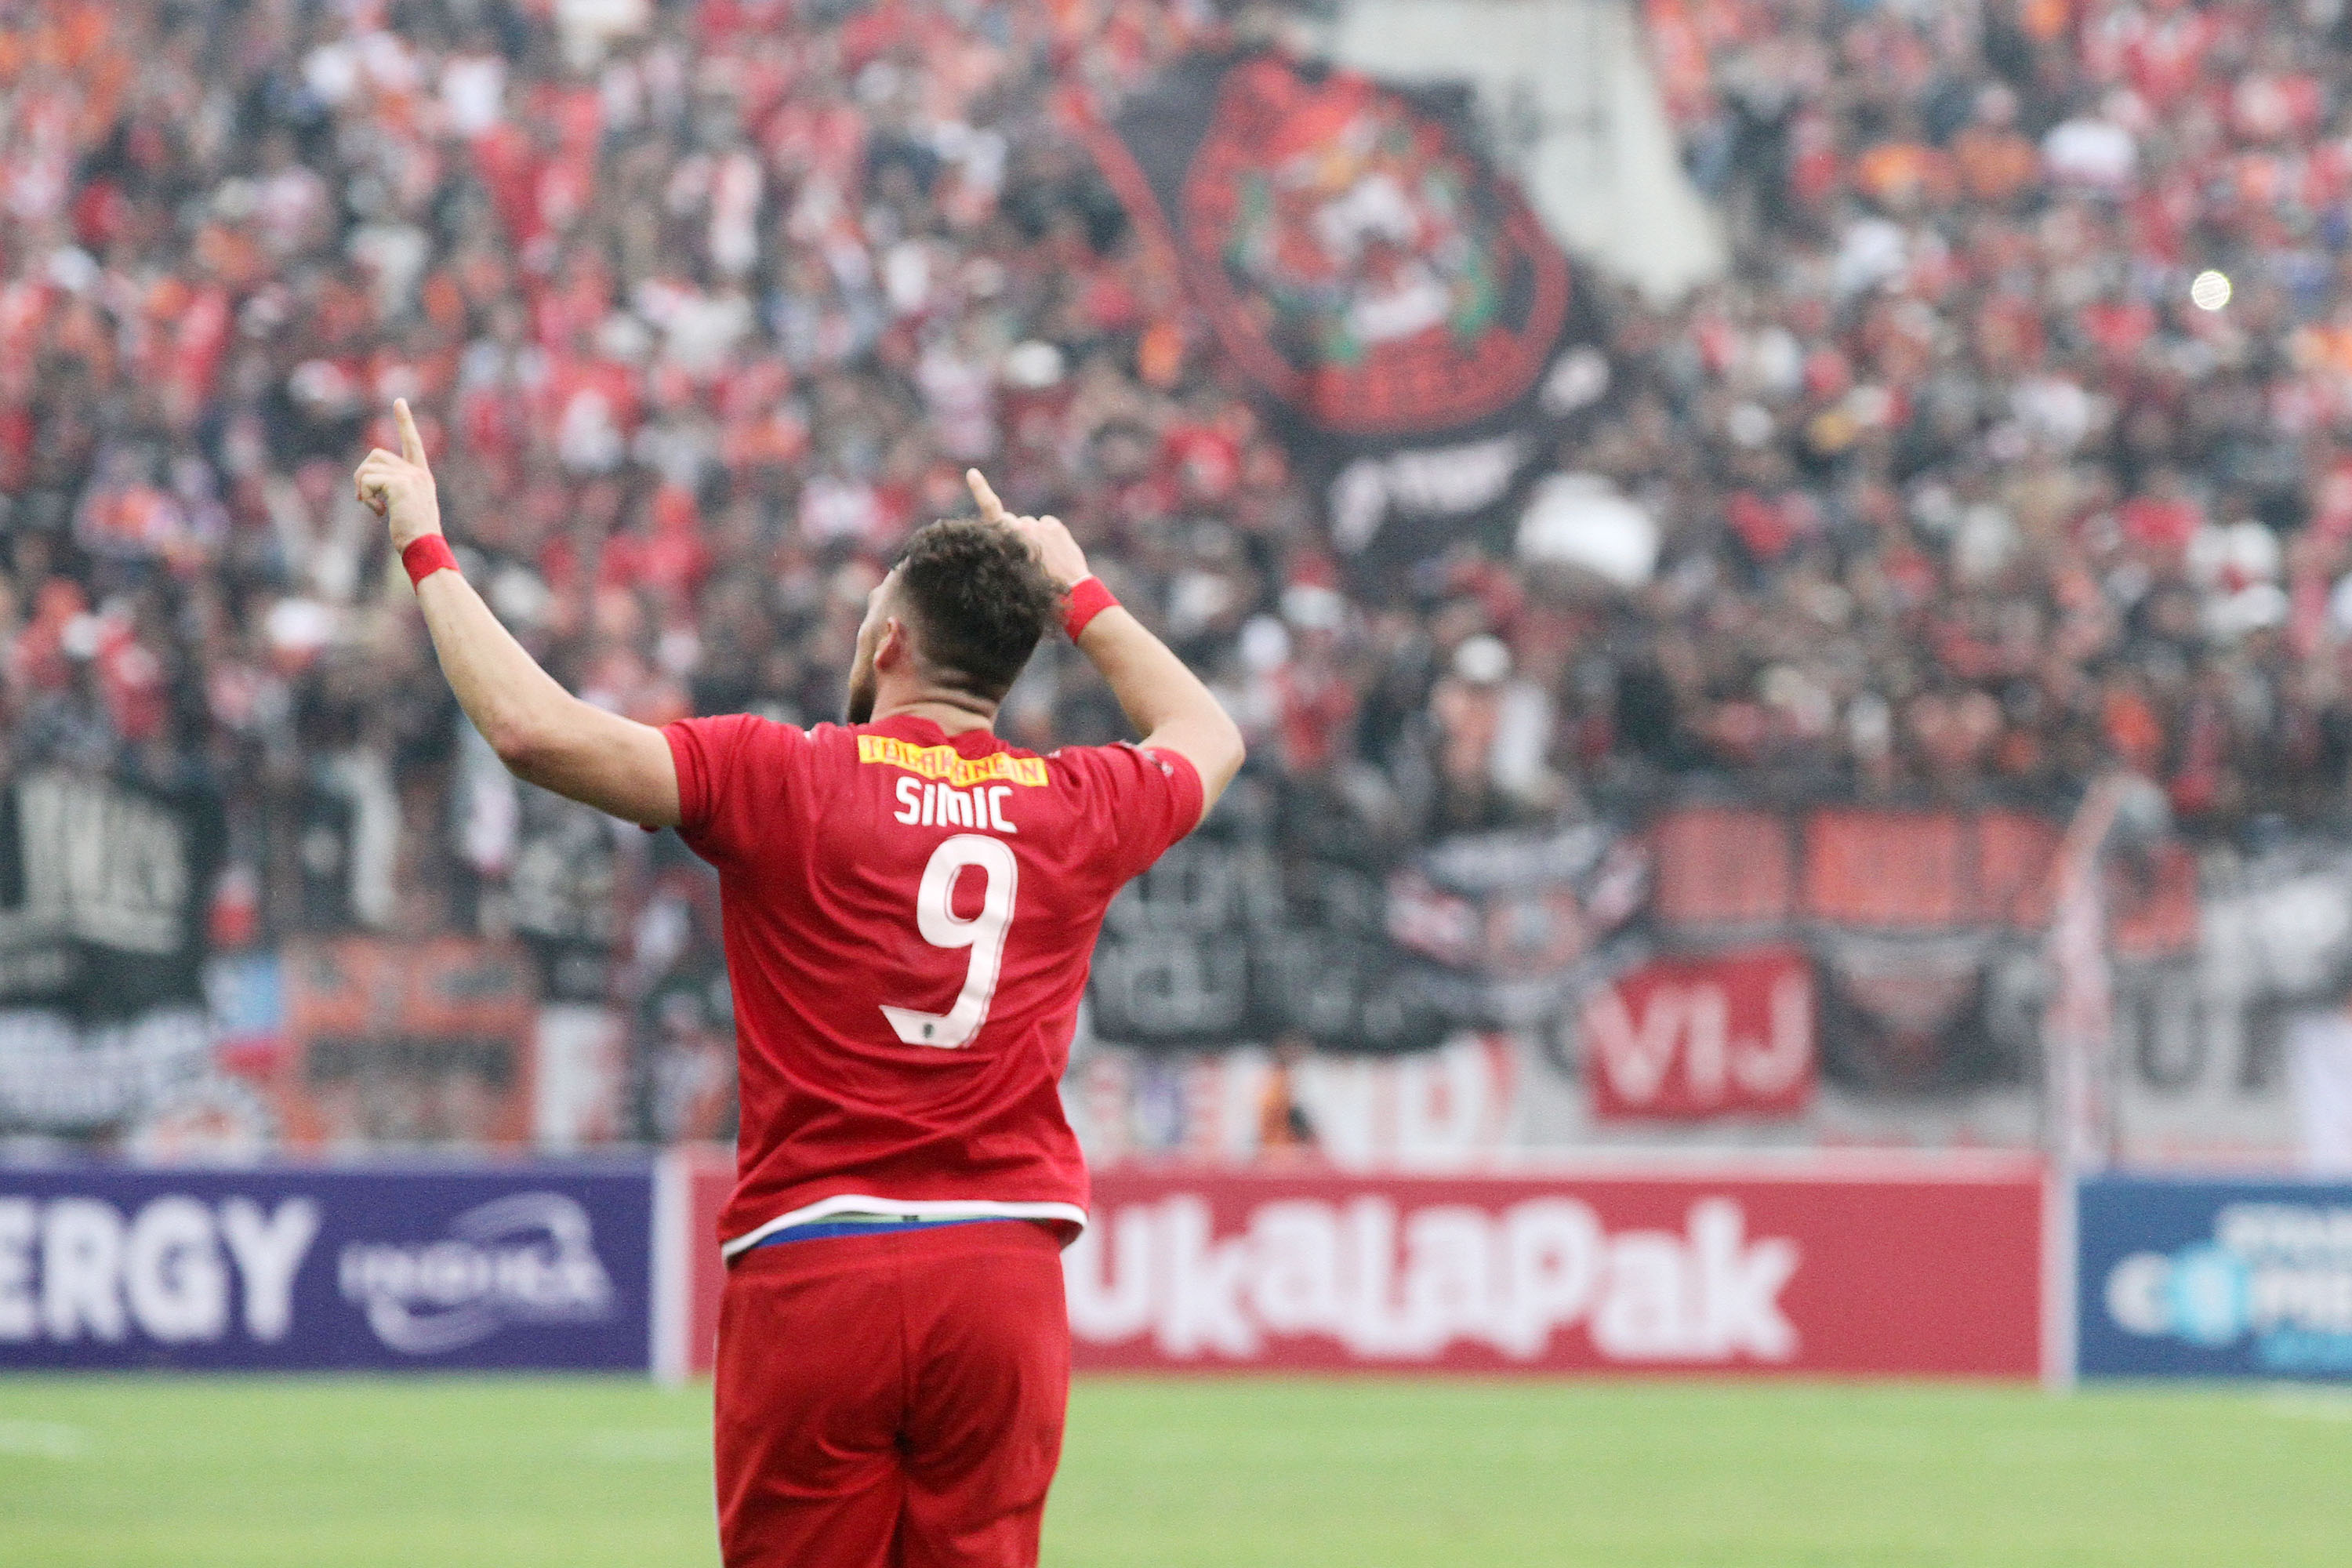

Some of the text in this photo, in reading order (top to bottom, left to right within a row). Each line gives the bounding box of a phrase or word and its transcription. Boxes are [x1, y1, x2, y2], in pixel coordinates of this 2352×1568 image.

[894, 776, 1018, 834] SIMIC
[879, 833, 1018, 1049] 9
[1587, 972, 1813, 1099] VIJ
[1068, 1193, 1802, 1361] ukalapak
